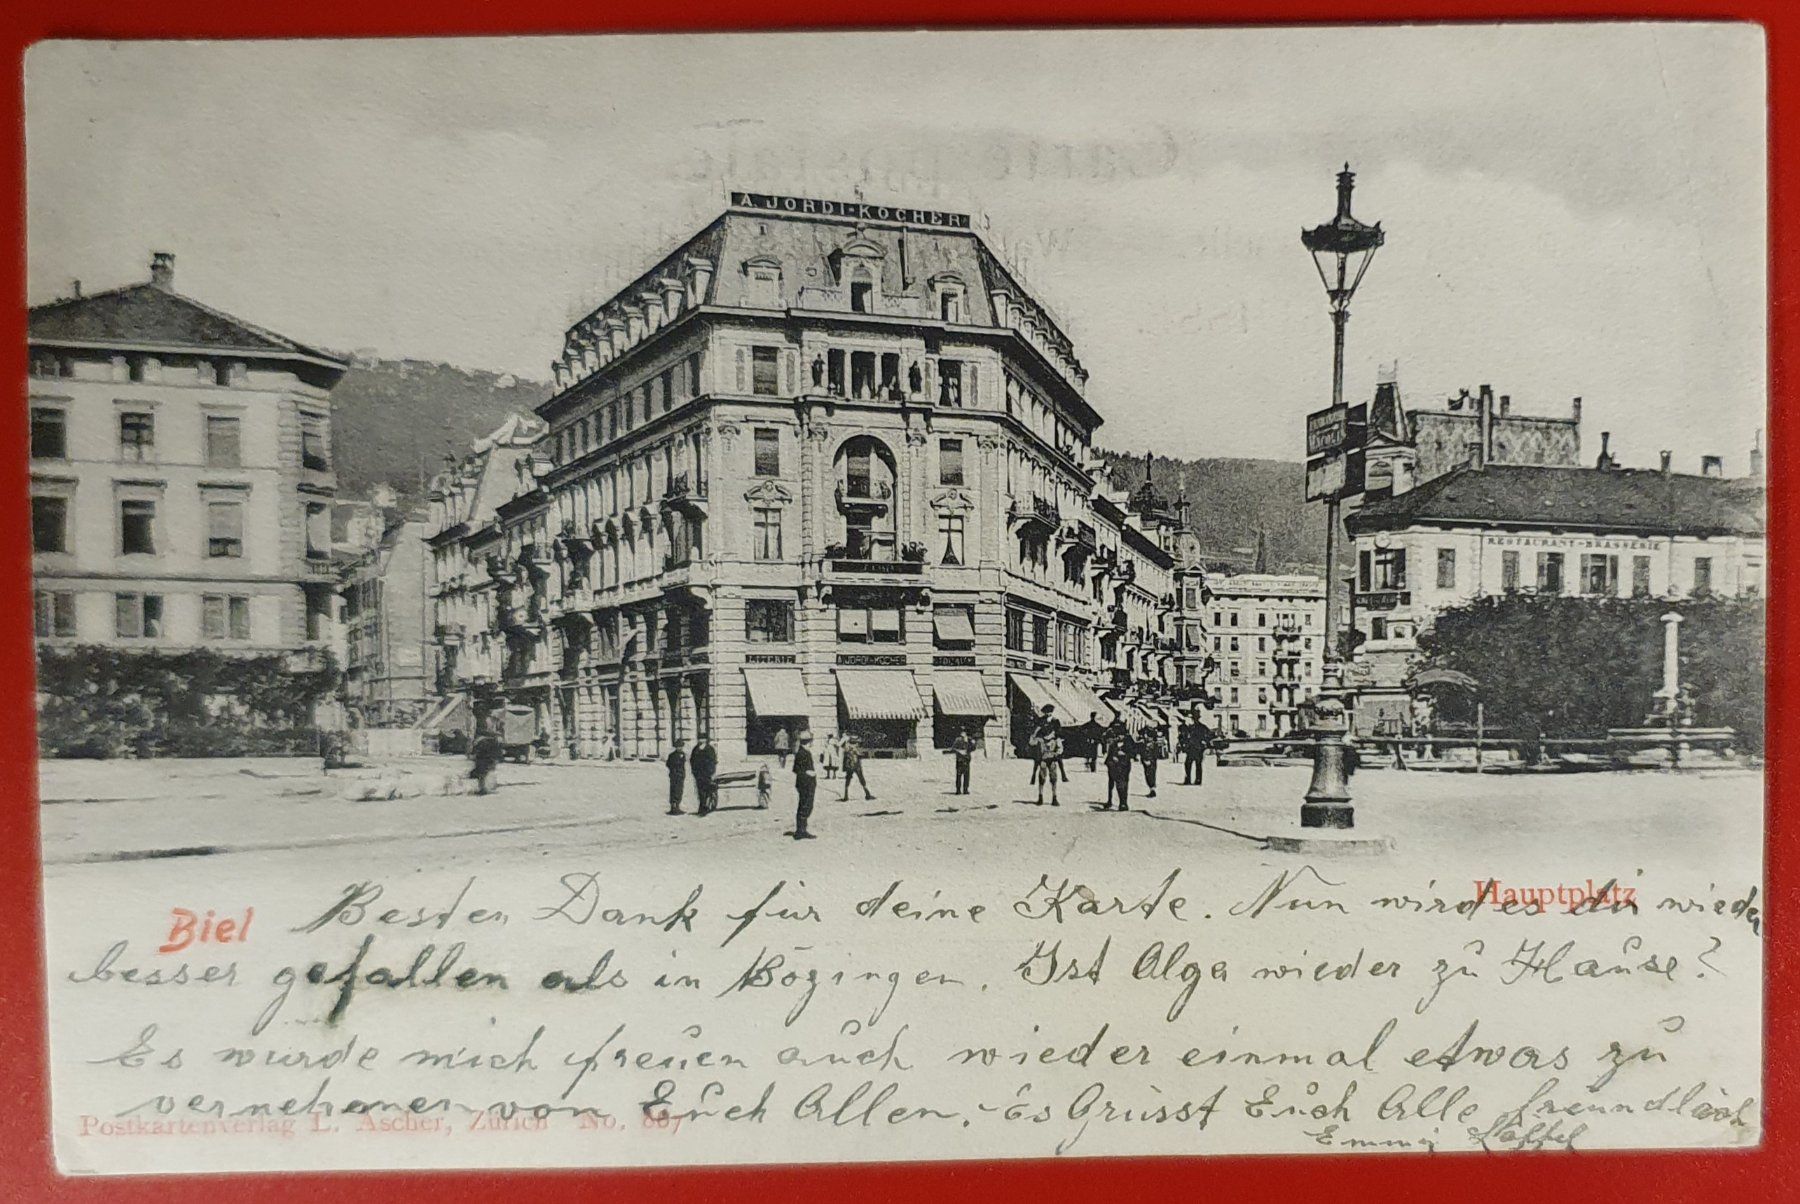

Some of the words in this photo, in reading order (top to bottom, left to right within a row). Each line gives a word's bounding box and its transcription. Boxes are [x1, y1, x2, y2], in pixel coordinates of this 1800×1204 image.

[740, 194, 758, 208] A.
[531, 871, 704, 933] Dank
[725, 879, 822, 949] für
[855, 880, 986, 925] deine
[1228, 864, 1350, 919] Nun
[1473, 879, 1638, 915] Hauptplatz
[157, 905, 254, 955] Biel
[653, 950, 701, 990] in
[1250, 947, 1401, 983] wieder
[398, 1015, 540, 1071] mich
[947, 1022, 1151, 1069] wieder
